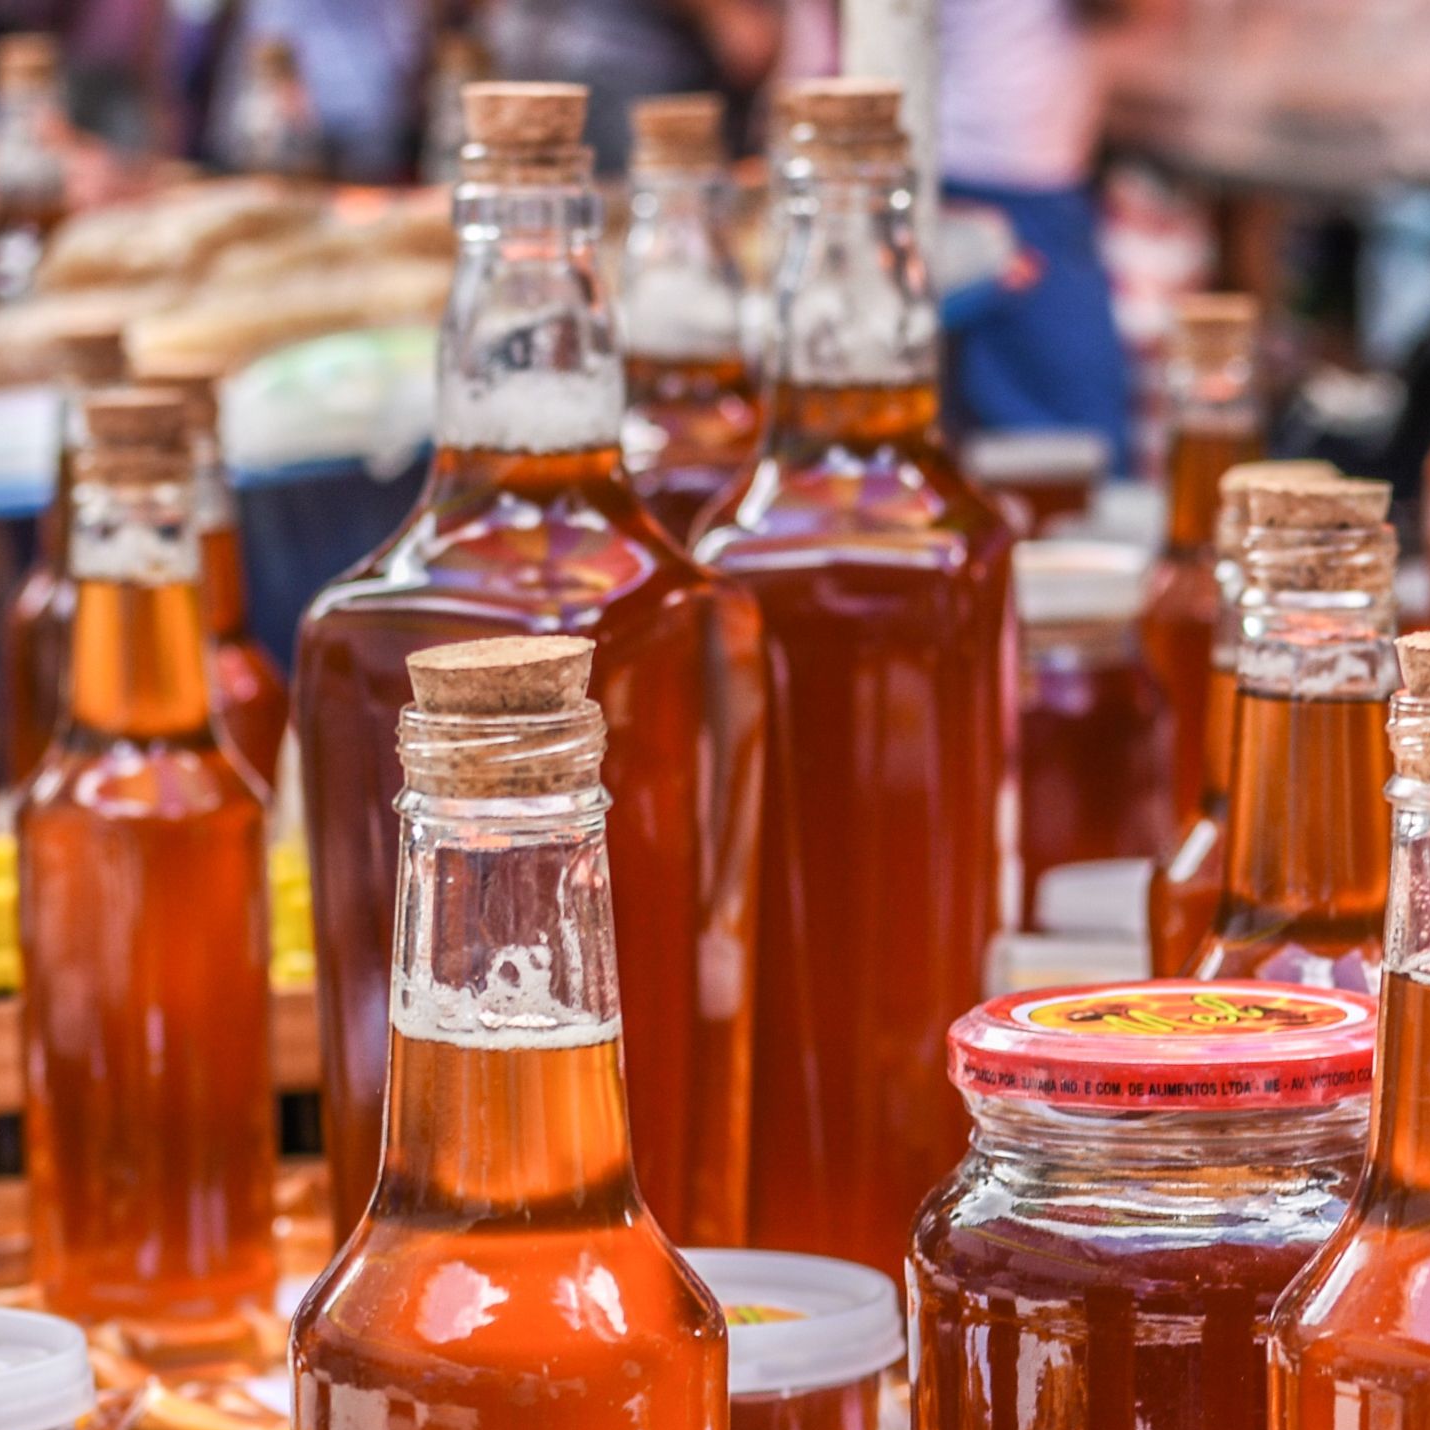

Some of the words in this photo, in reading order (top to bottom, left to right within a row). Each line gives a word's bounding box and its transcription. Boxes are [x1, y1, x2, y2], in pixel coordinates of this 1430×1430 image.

[1084, 1081, 1091, 1095] E
[1128, 1082, 1144, 1096] DE
[1148, 1082, 1218, 1097] ALIMENTOS
[1221, 1080, 1252, 1096] LTDA
